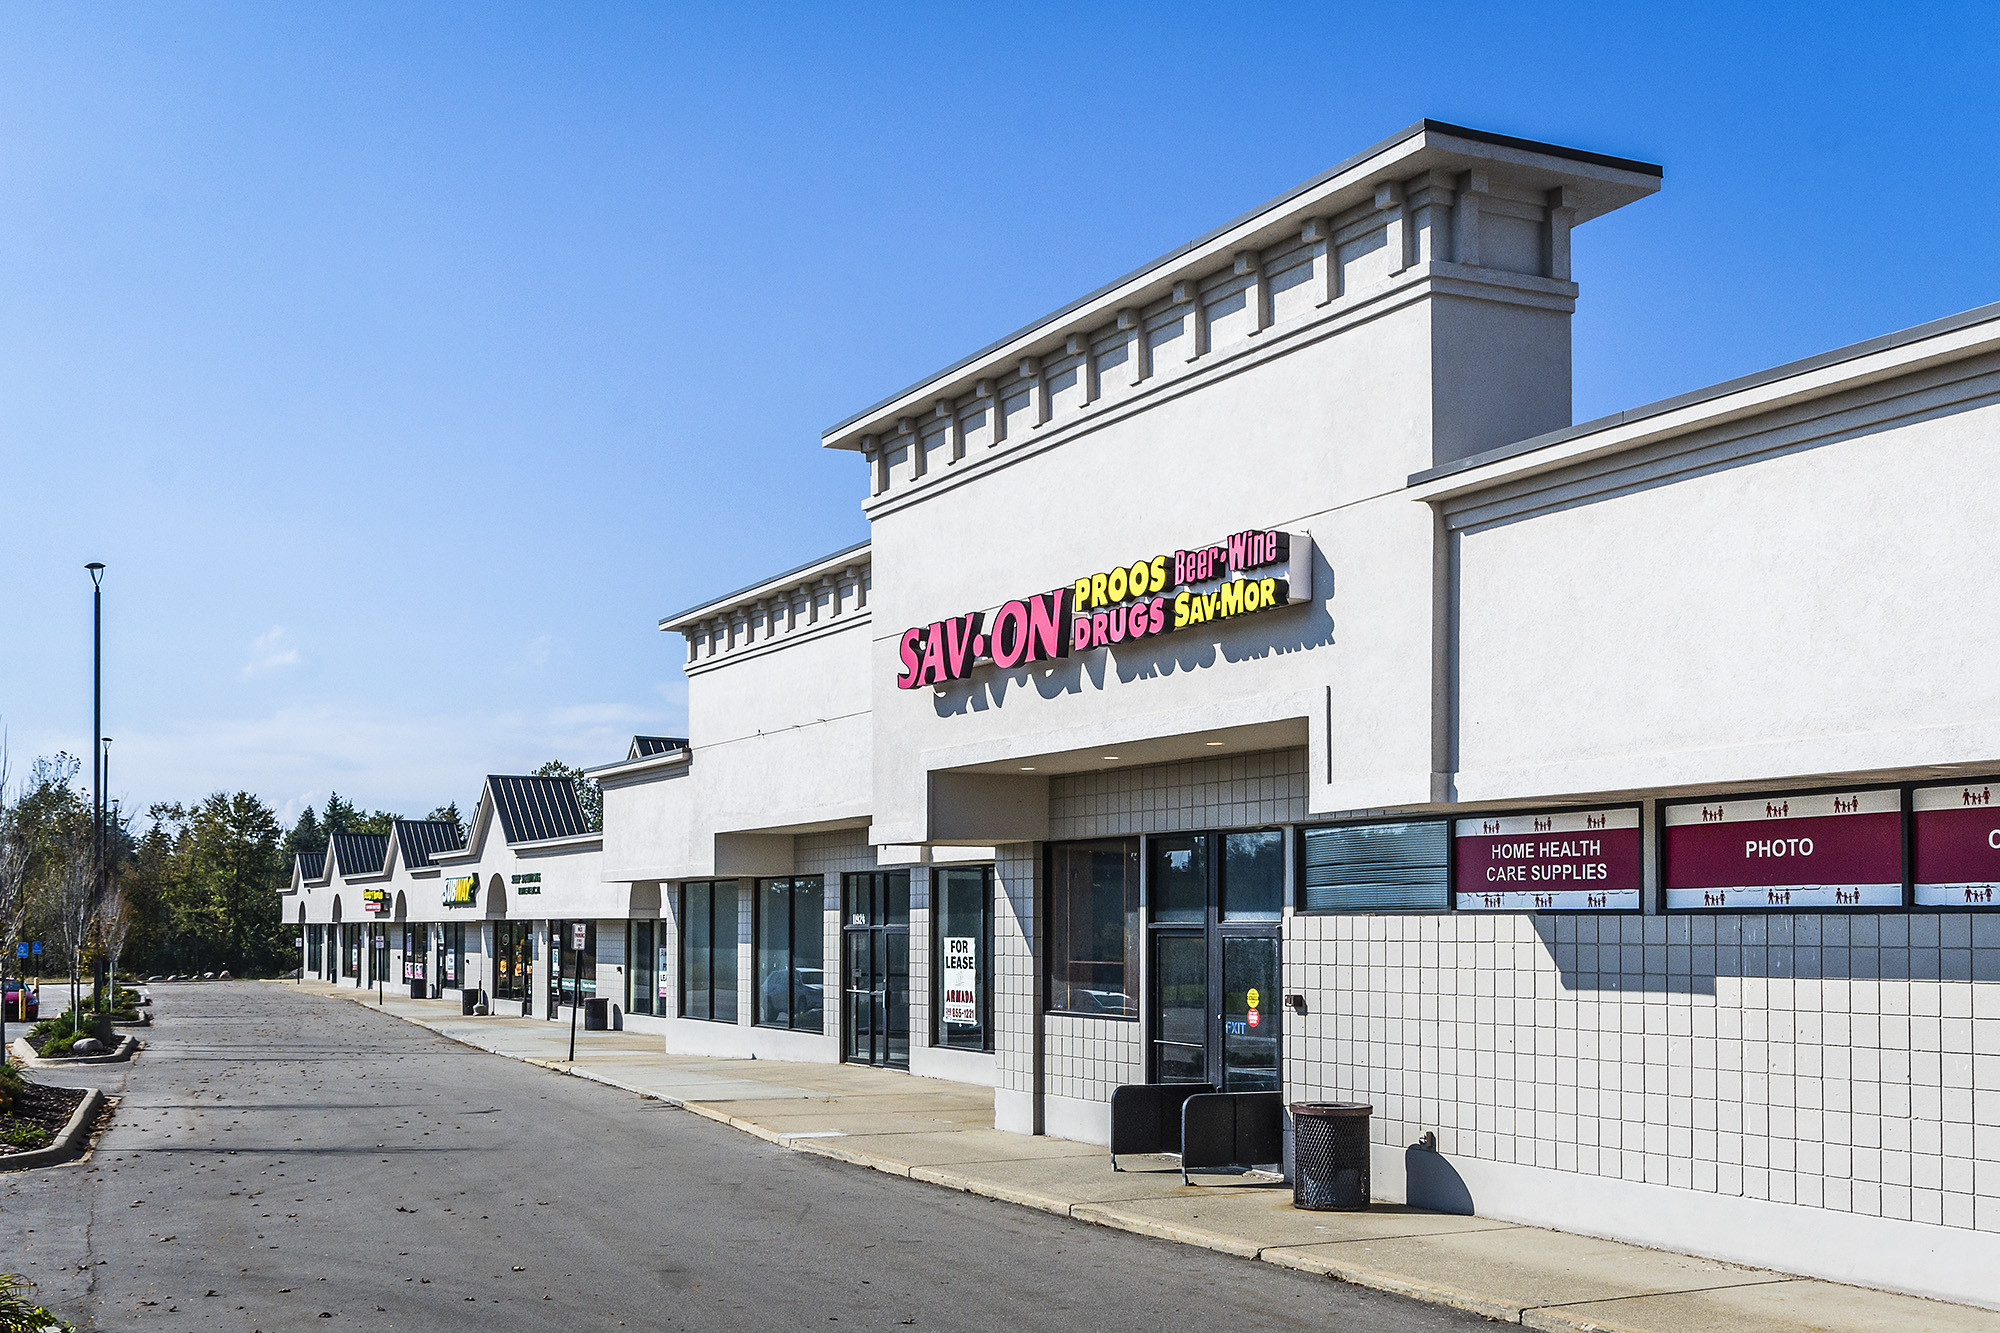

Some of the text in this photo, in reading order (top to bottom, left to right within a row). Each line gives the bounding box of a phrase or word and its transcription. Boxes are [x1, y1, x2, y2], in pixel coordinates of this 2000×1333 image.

[1075, 555, 1167, 612] PROOS
[1074, 598, 1166, 651] DRUGS
[1491, 839, 1601, 859] HOME HEALTH
[1745, 837, 1814, 859] PHOTO
[1486, 863, 1608, 882] CARE SUPPLIES
[442, 876, 474, 903] SUBWAY
[950, 939, 969, 954] FOR
[945, 955, 974, 970] LEASE
[945, 989, 974, 1004] ARMADA
